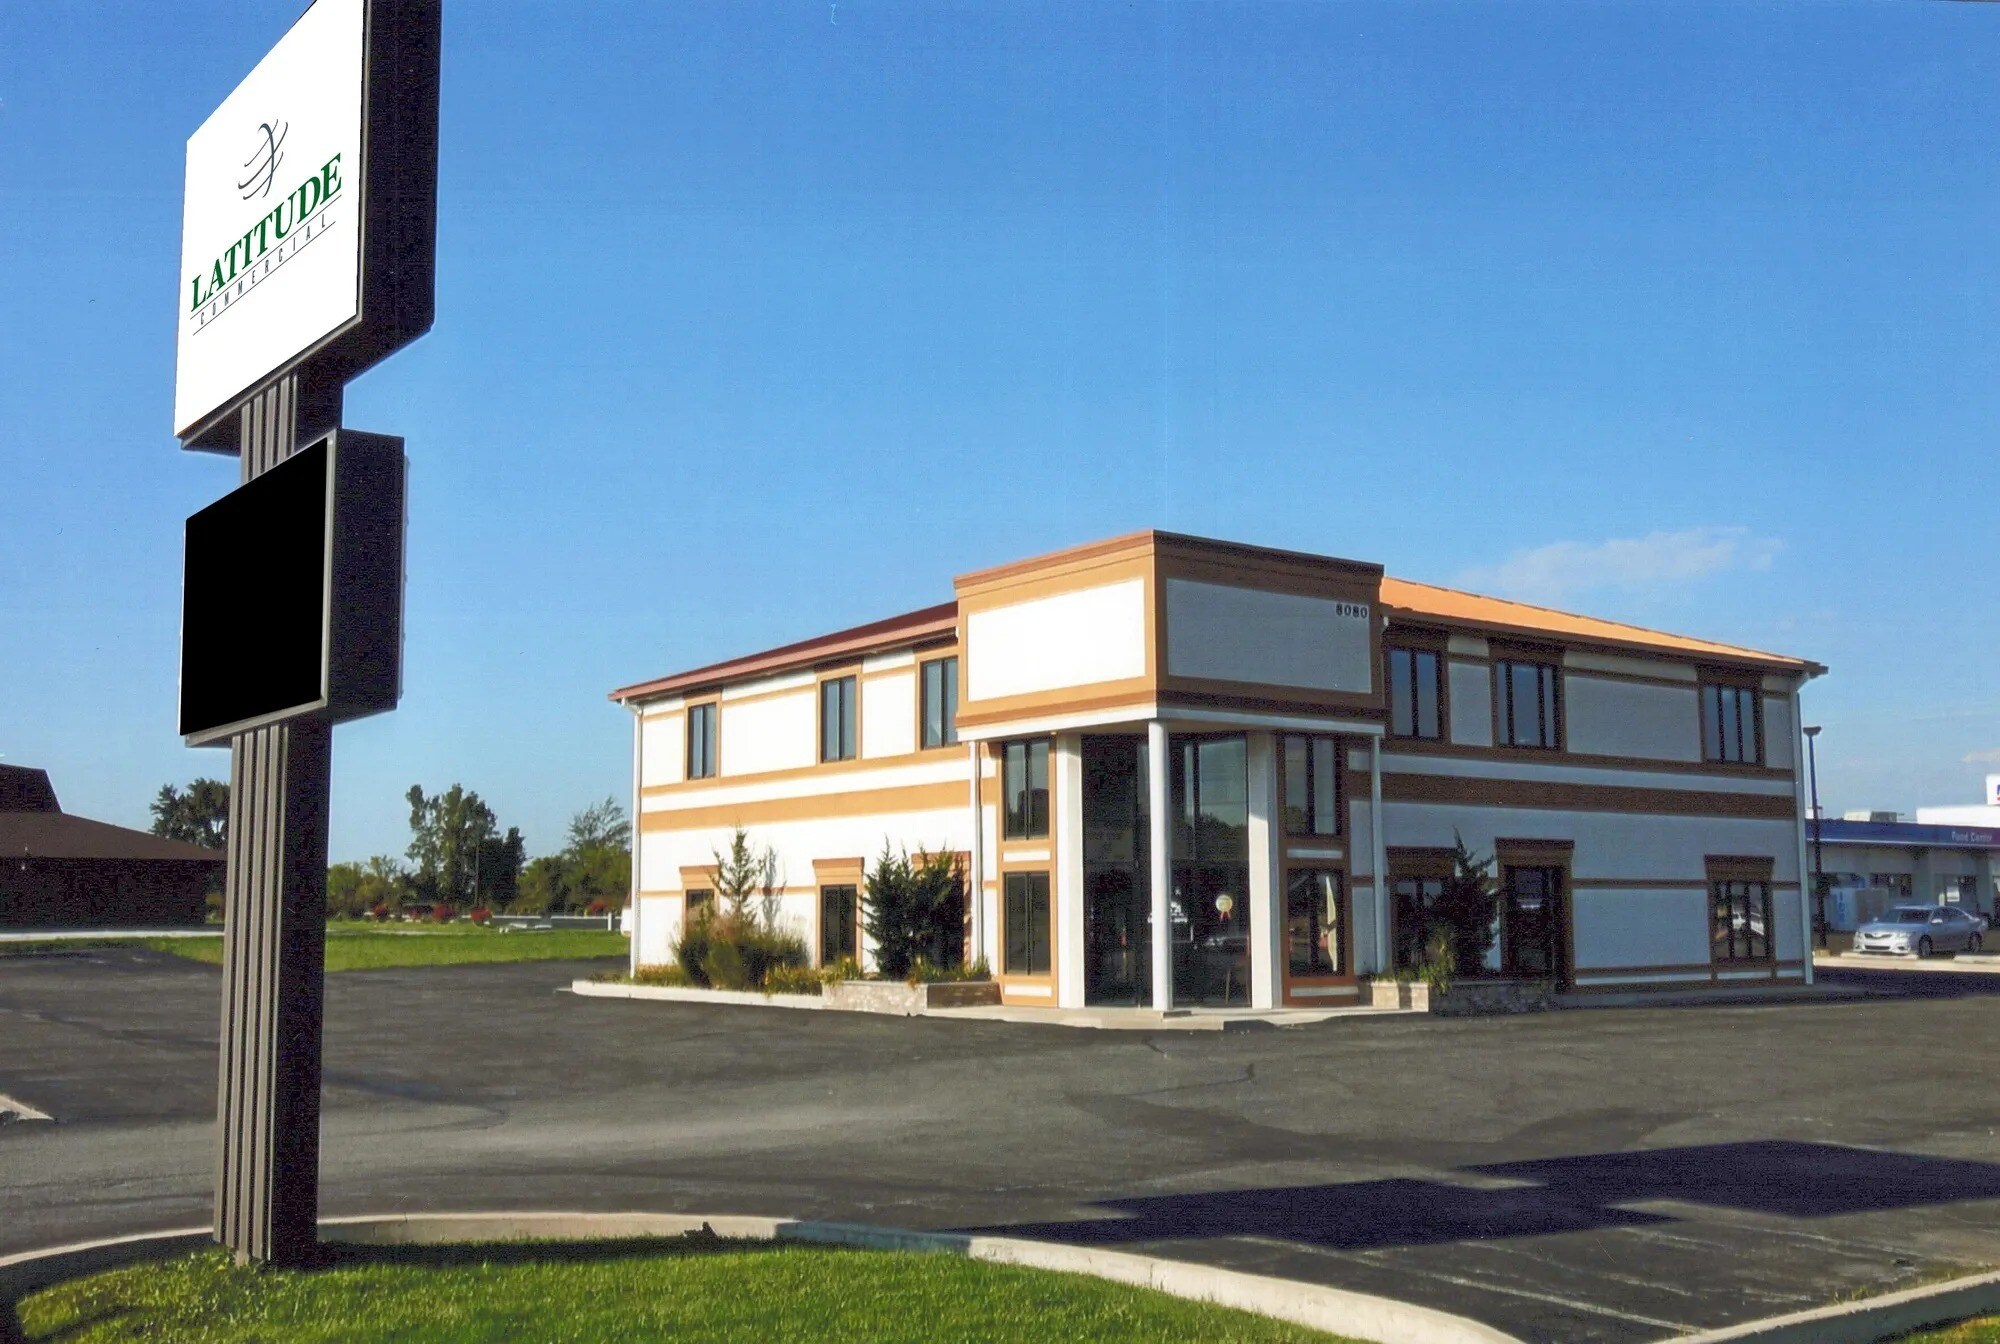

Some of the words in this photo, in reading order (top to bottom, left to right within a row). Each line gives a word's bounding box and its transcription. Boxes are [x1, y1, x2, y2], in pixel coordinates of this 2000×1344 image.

[191, 152, 342, 312] LATITUDE
[200, 213, 326, 325] COMMERCIAL
[1336, 603, 1368, 619] 8080
